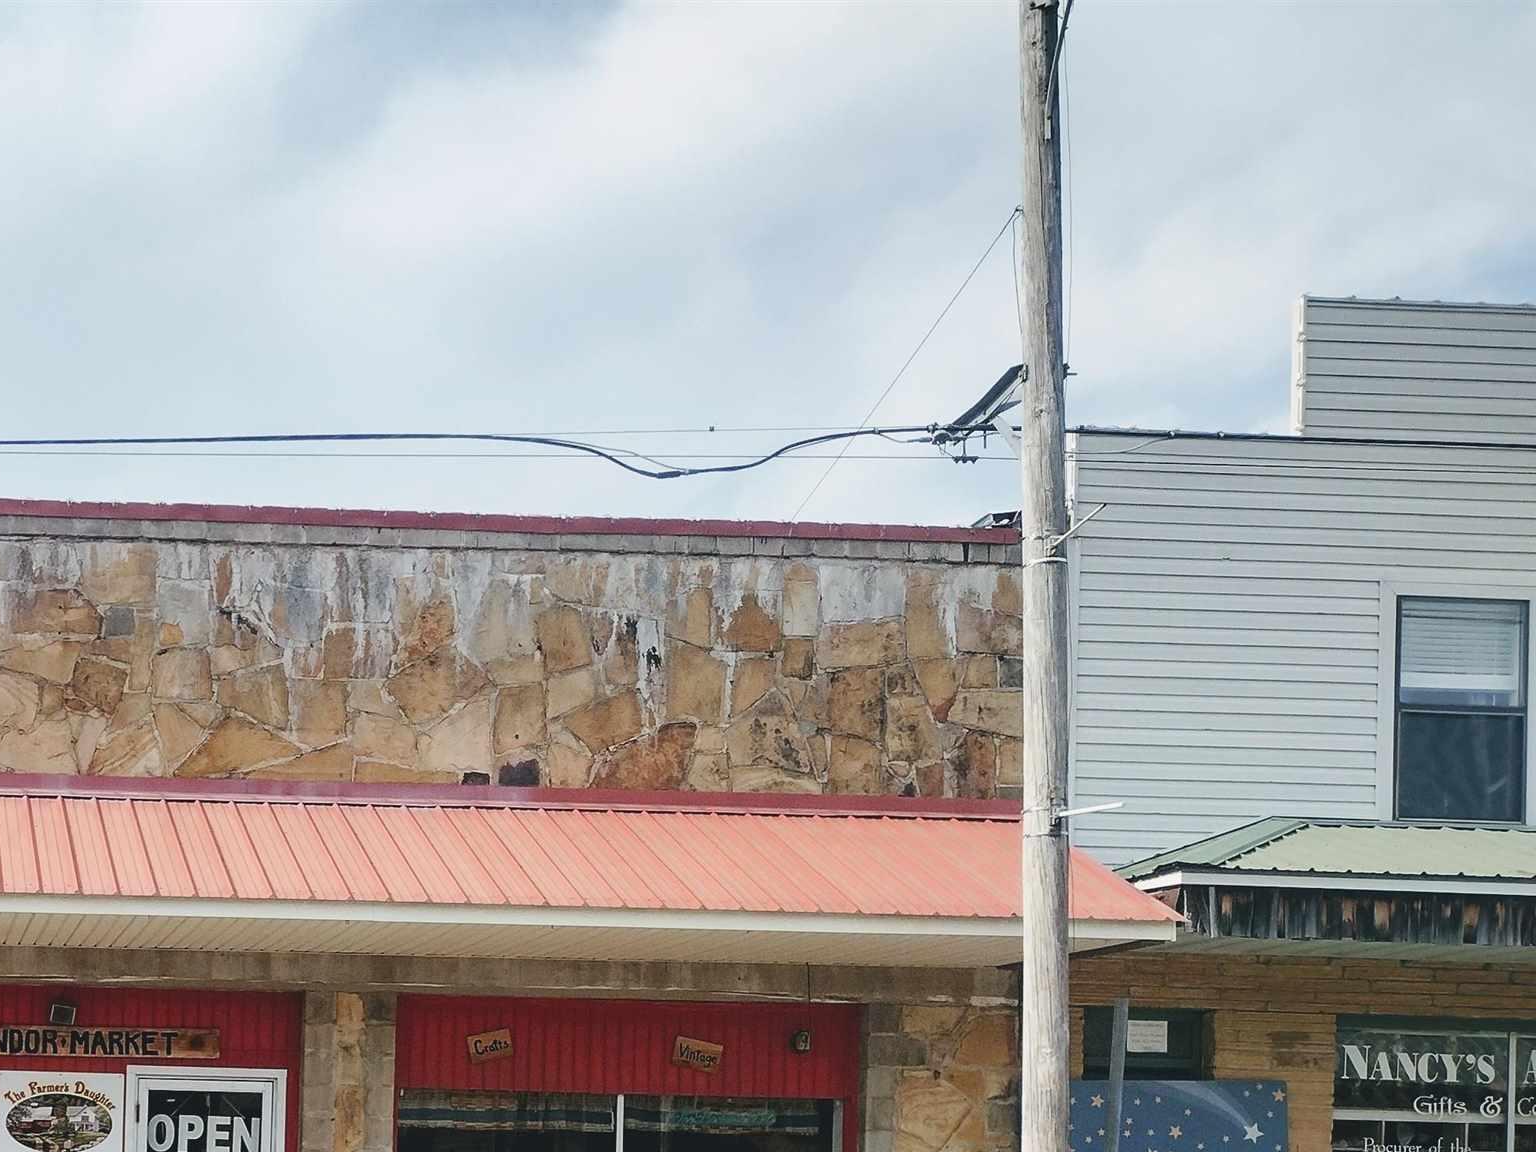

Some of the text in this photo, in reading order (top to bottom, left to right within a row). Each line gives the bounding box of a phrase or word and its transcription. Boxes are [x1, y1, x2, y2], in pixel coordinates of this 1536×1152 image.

[69, 1030, 179, 1056] MARKET
[473, 1039, 510, 1055] Crafts
[679, 1042, 718, 1069] Vintage
[1340, 1044, 1497, 1085] NANCY'S
[4, 1080, 116, 1111] The Farmer's Daughter
[1413, 1093, 1468, 1120] Gifts
[1479, 1096, 1504, 1119] &
